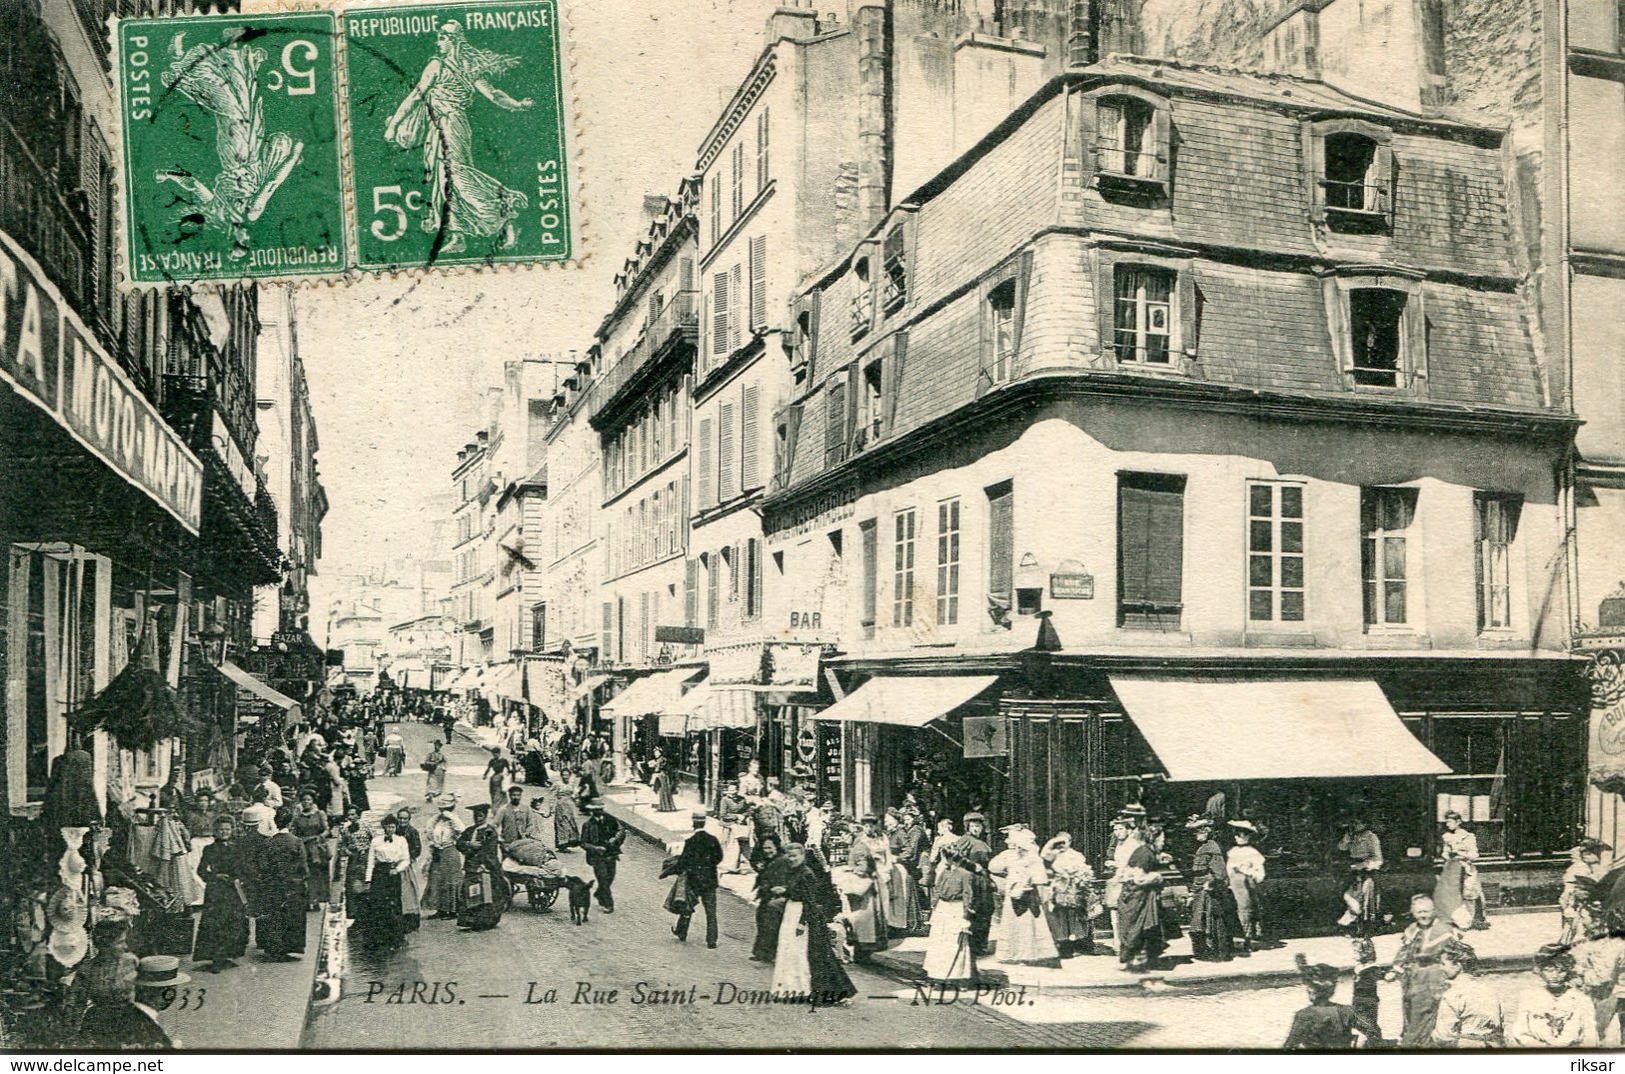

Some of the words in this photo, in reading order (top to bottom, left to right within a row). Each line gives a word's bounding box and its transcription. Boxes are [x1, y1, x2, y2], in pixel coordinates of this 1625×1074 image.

[349, 14, 439, 37] REPUBLIQUE
[465, 9, 549, 31] FRANÇAISE
[129, 35, 152, 121] POSTES
[537, 159, 561, 244] POSTES
[789, 611, 823, 630] BAR
[273, 633, 303, 644] BAZAR
